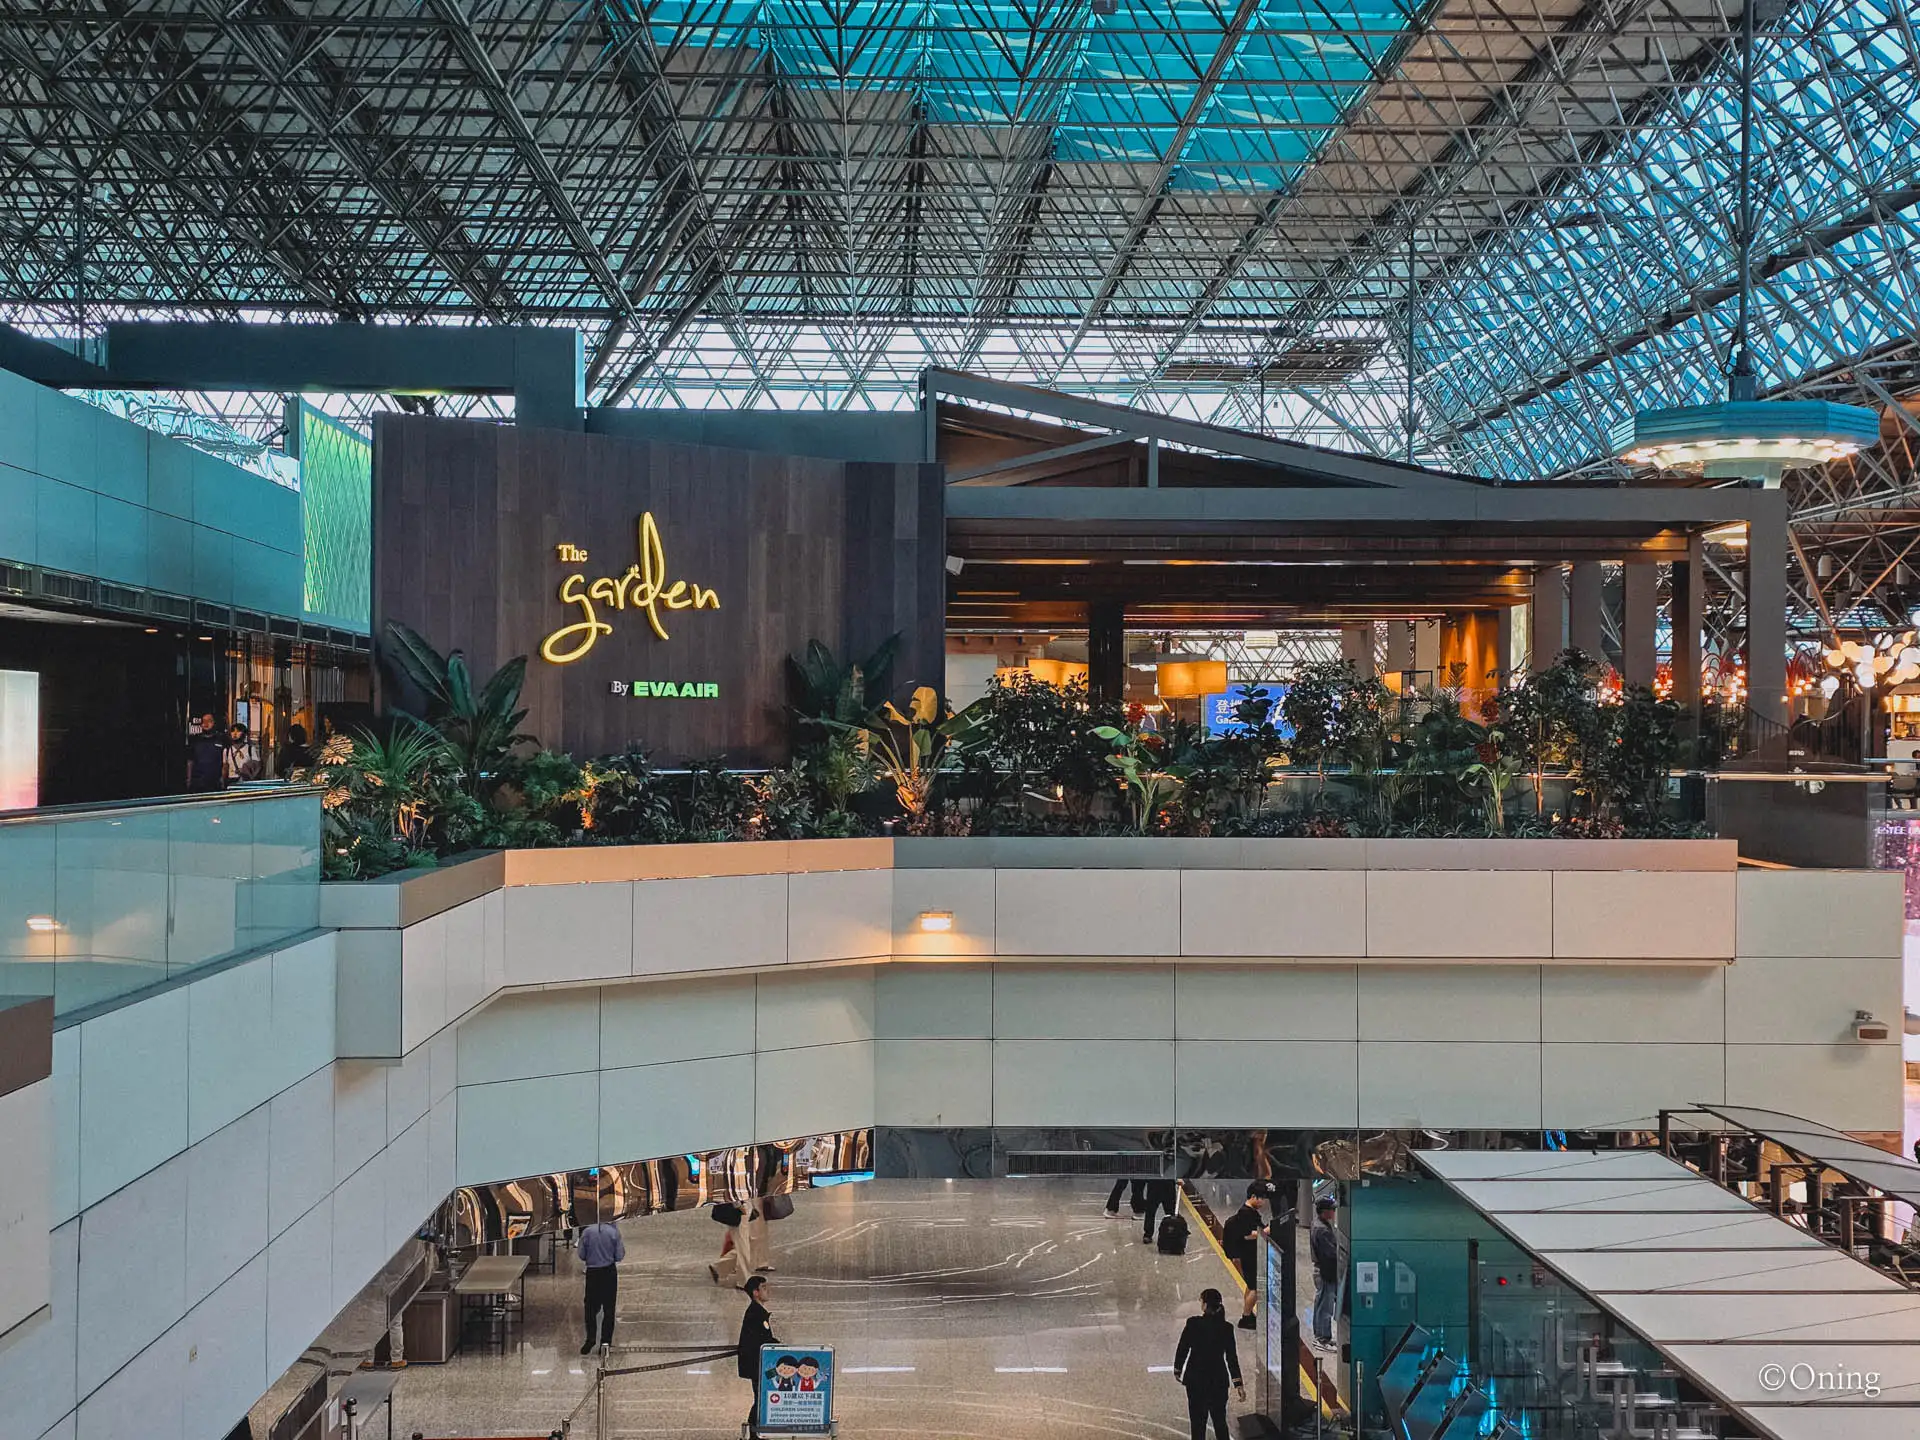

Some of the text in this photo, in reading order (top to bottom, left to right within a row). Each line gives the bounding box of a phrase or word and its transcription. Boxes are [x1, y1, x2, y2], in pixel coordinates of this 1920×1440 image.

[558, 544, 588, 562] The
[541, 511, 721, 664] garden
[612, 681, 629, 696] By
